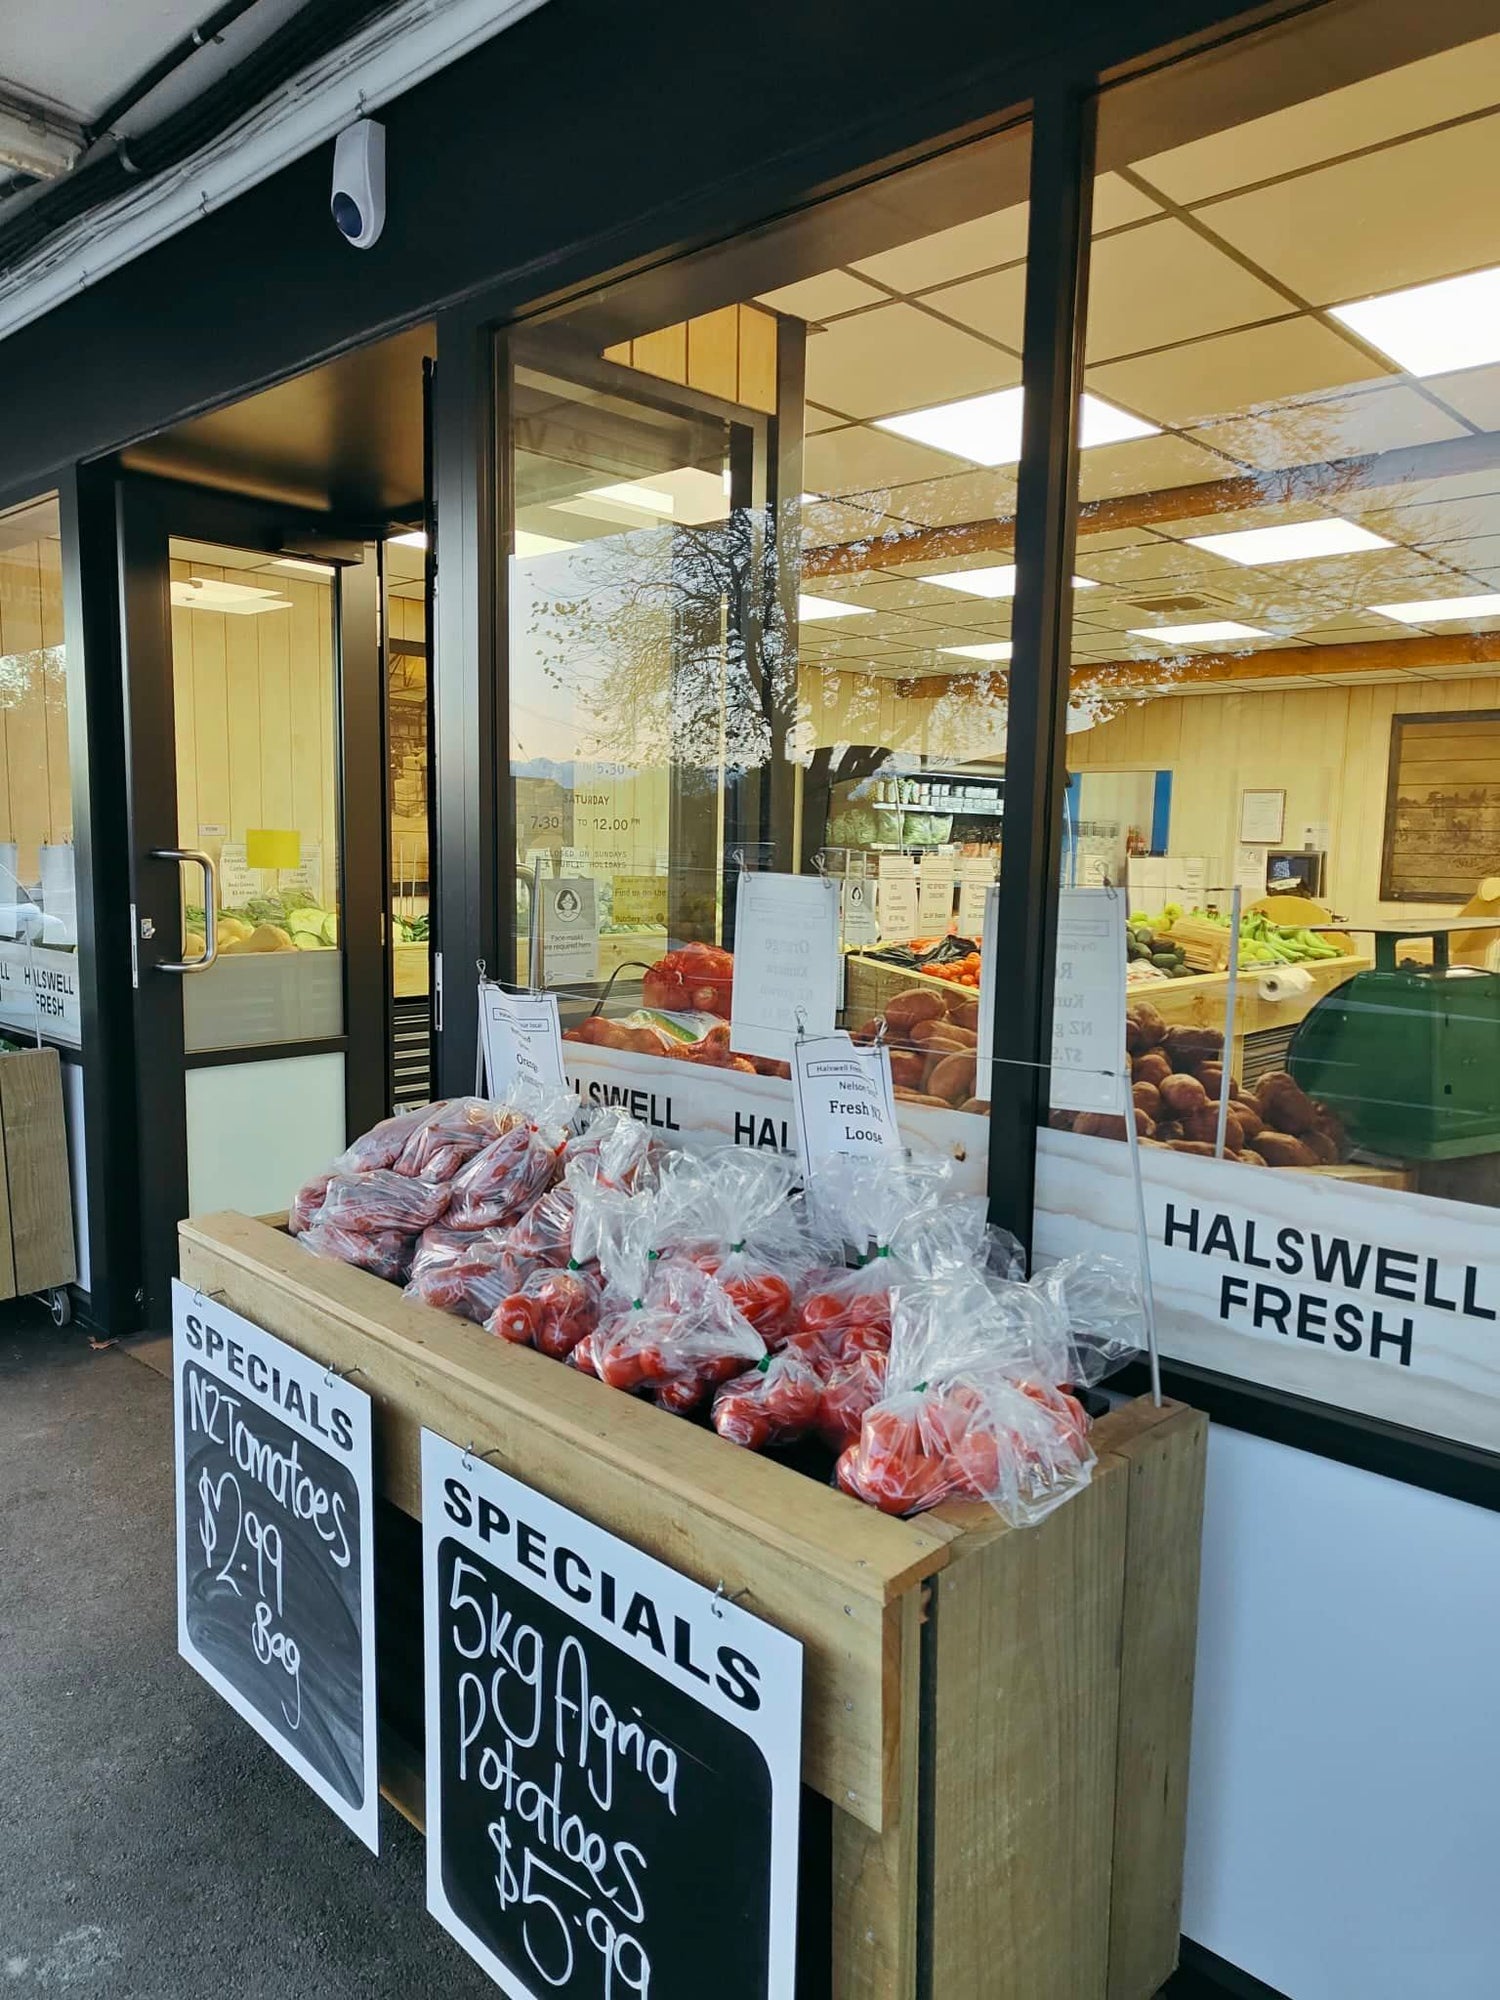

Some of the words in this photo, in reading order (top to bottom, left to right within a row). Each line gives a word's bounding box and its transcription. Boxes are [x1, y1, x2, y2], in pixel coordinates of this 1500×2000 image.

[530, 815, 559, 830] 7.30
[592, 818, 628, 831] 12.00
[563, 794, 610, 806] SATURDAY
[594, 850, 628, 859] SUNDAYS
[828, 1100, 870, 1116] Fresh
[845, 1126, 883, 1145] Loose
[1163, 1203, 1497, 1321] HALSWELL
[1219, 1275, 1413, 1367] FRESH
[186, 1314, 353, 1451] SPECIALS
[199, 1467, 284, 1618] $2.99
[444, 1478, 760, 1711] SPECIALS
[251, 1602, 301, 1730] Bag
[450, 1556, 544, 1748] 5kg
[554, 1635, 677, 1816] Agria
[459, 1672, 647, 1924] Potatoes
[488, 1816, 651, 2000] $5.99
